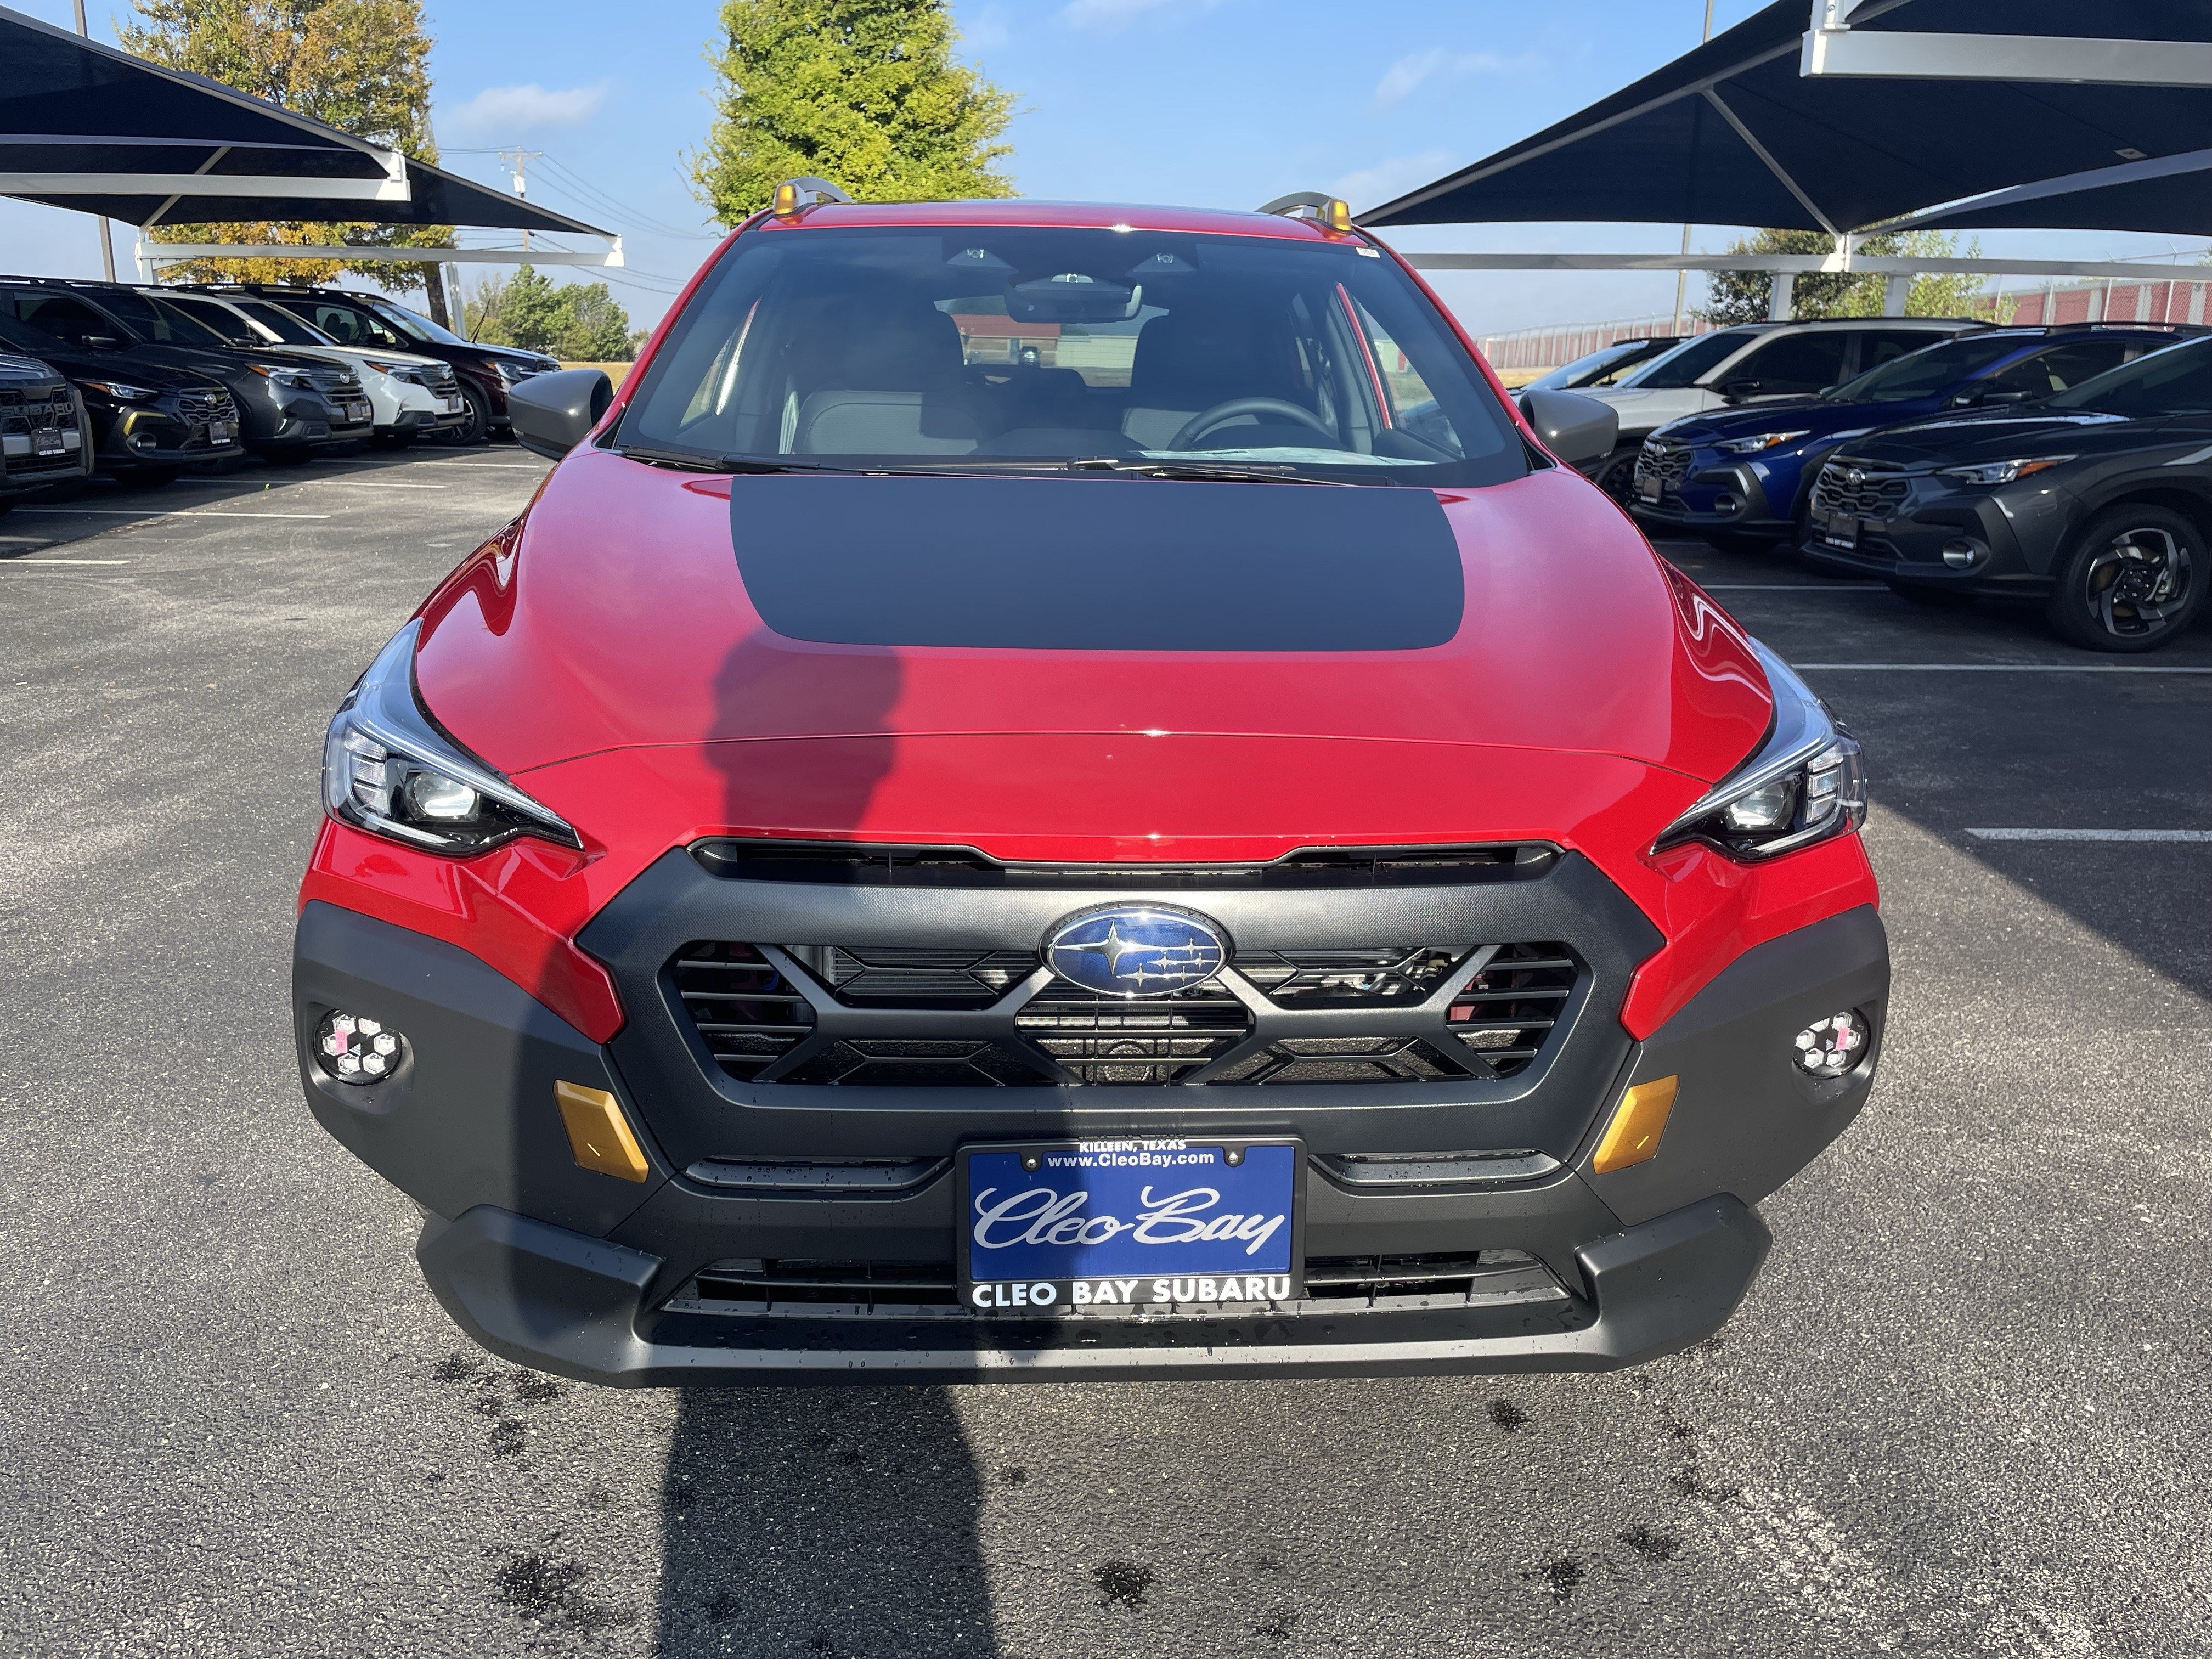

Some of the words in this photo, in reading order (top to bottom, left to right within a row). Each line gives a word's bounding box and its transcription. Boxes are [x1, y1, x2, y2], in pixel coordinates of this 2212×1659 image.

[1079, 1141, 1137, 1153] KILLEEN,
[1142, 1139, 1186, 1151] TEXAS
[1047, 1153, 1214, 1167] www.CleoBay.com
[974, 1188, 1135, 1249] Cleo
[1132, 1185, 1285, 1255] Bay
[972, 1283, 1057, 1307] CLEO
[1073, 1280, 1139, 1305] BAY
[1152, 1277, 1291, 1303] SUBARU
